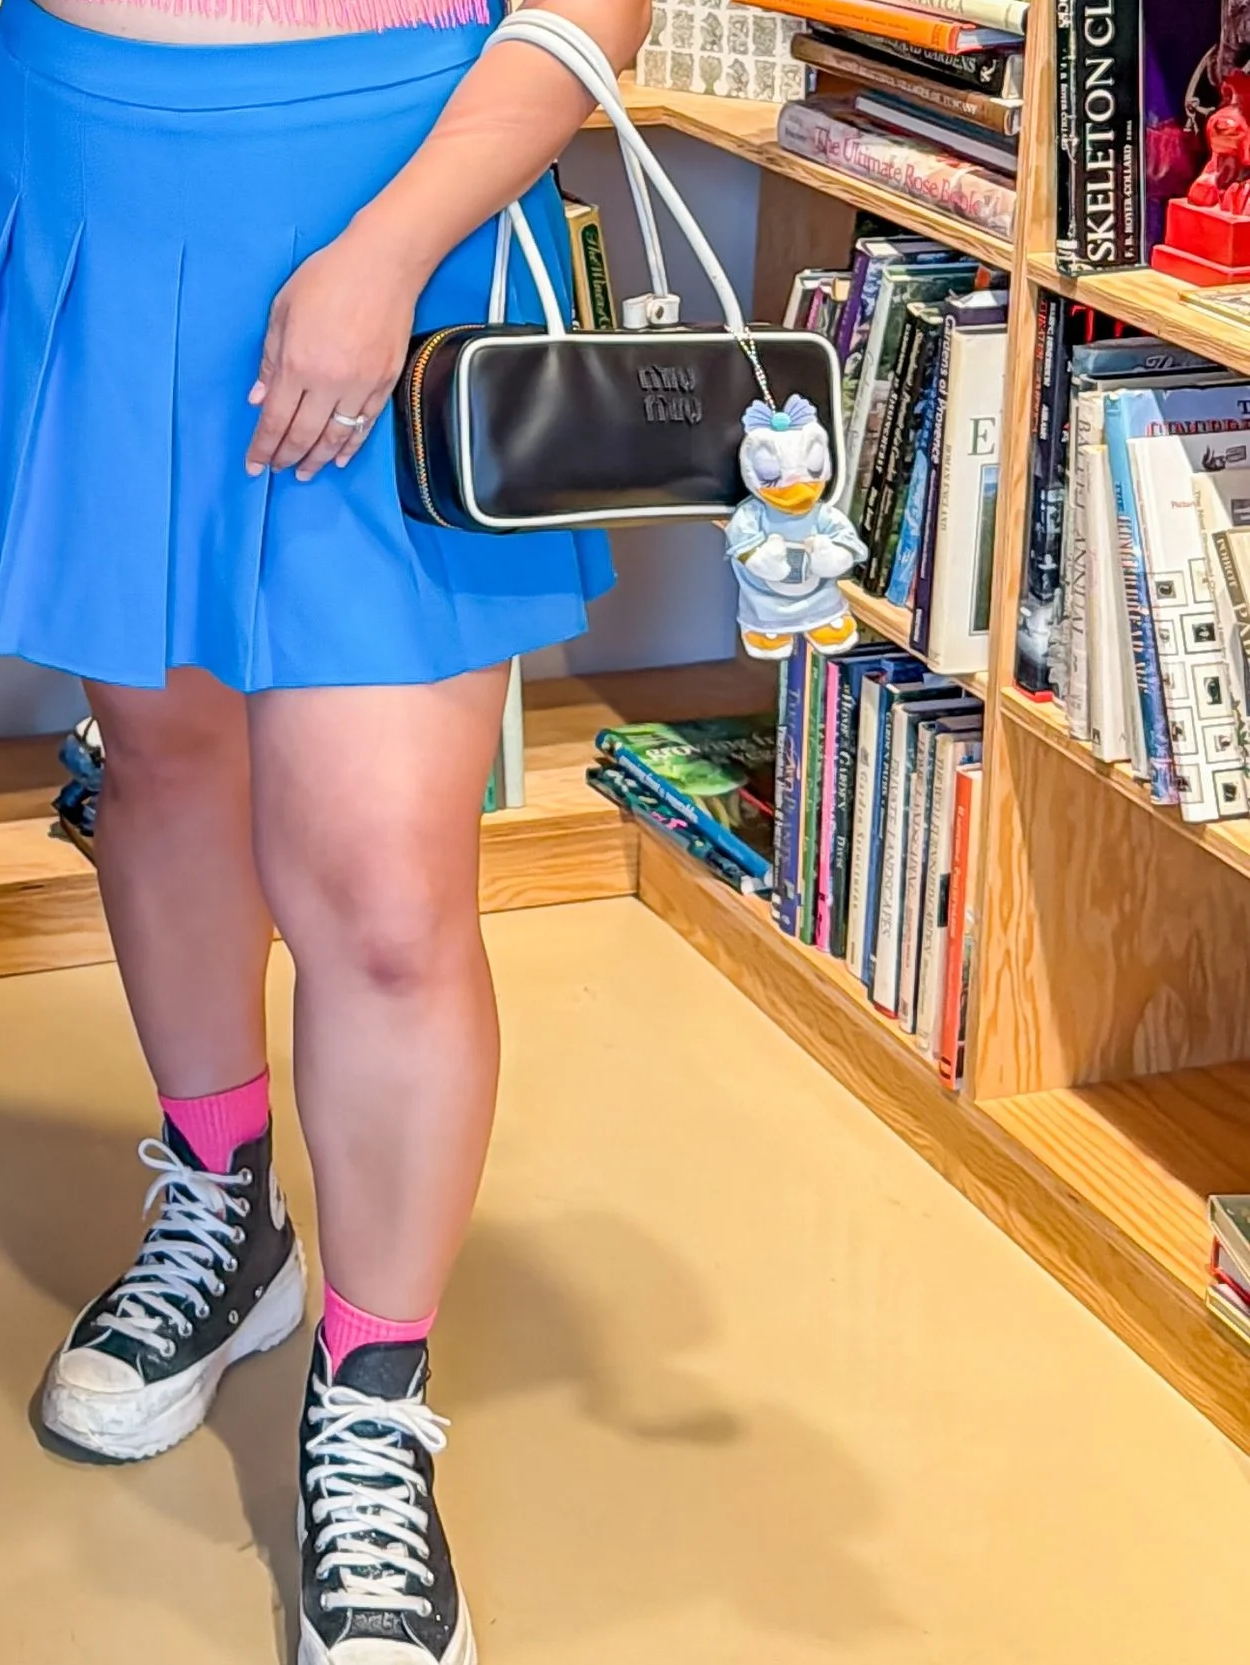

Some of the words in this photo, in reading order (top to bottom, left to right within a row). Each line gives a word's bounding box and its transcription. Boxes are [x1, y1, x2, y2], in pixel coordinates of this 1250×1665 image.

[813, 125, 840, 157] The
[841, 131, 902, 183] Ultimate
[904, 162, 938, 199] Rose
[1085, 56, 1117, 263] SKELETON
[939, 314, 957, 376] Gardens
[938, 379, 949, 396] of
[930, 396, 947, 465] Provence
[1216, 537, 1238, 588] POIROT
[856, 770, 869, 826] Garden
[888, 758, 901, 826] PRIVATE
[881, 828, 898, 940] LANDSCAPES
